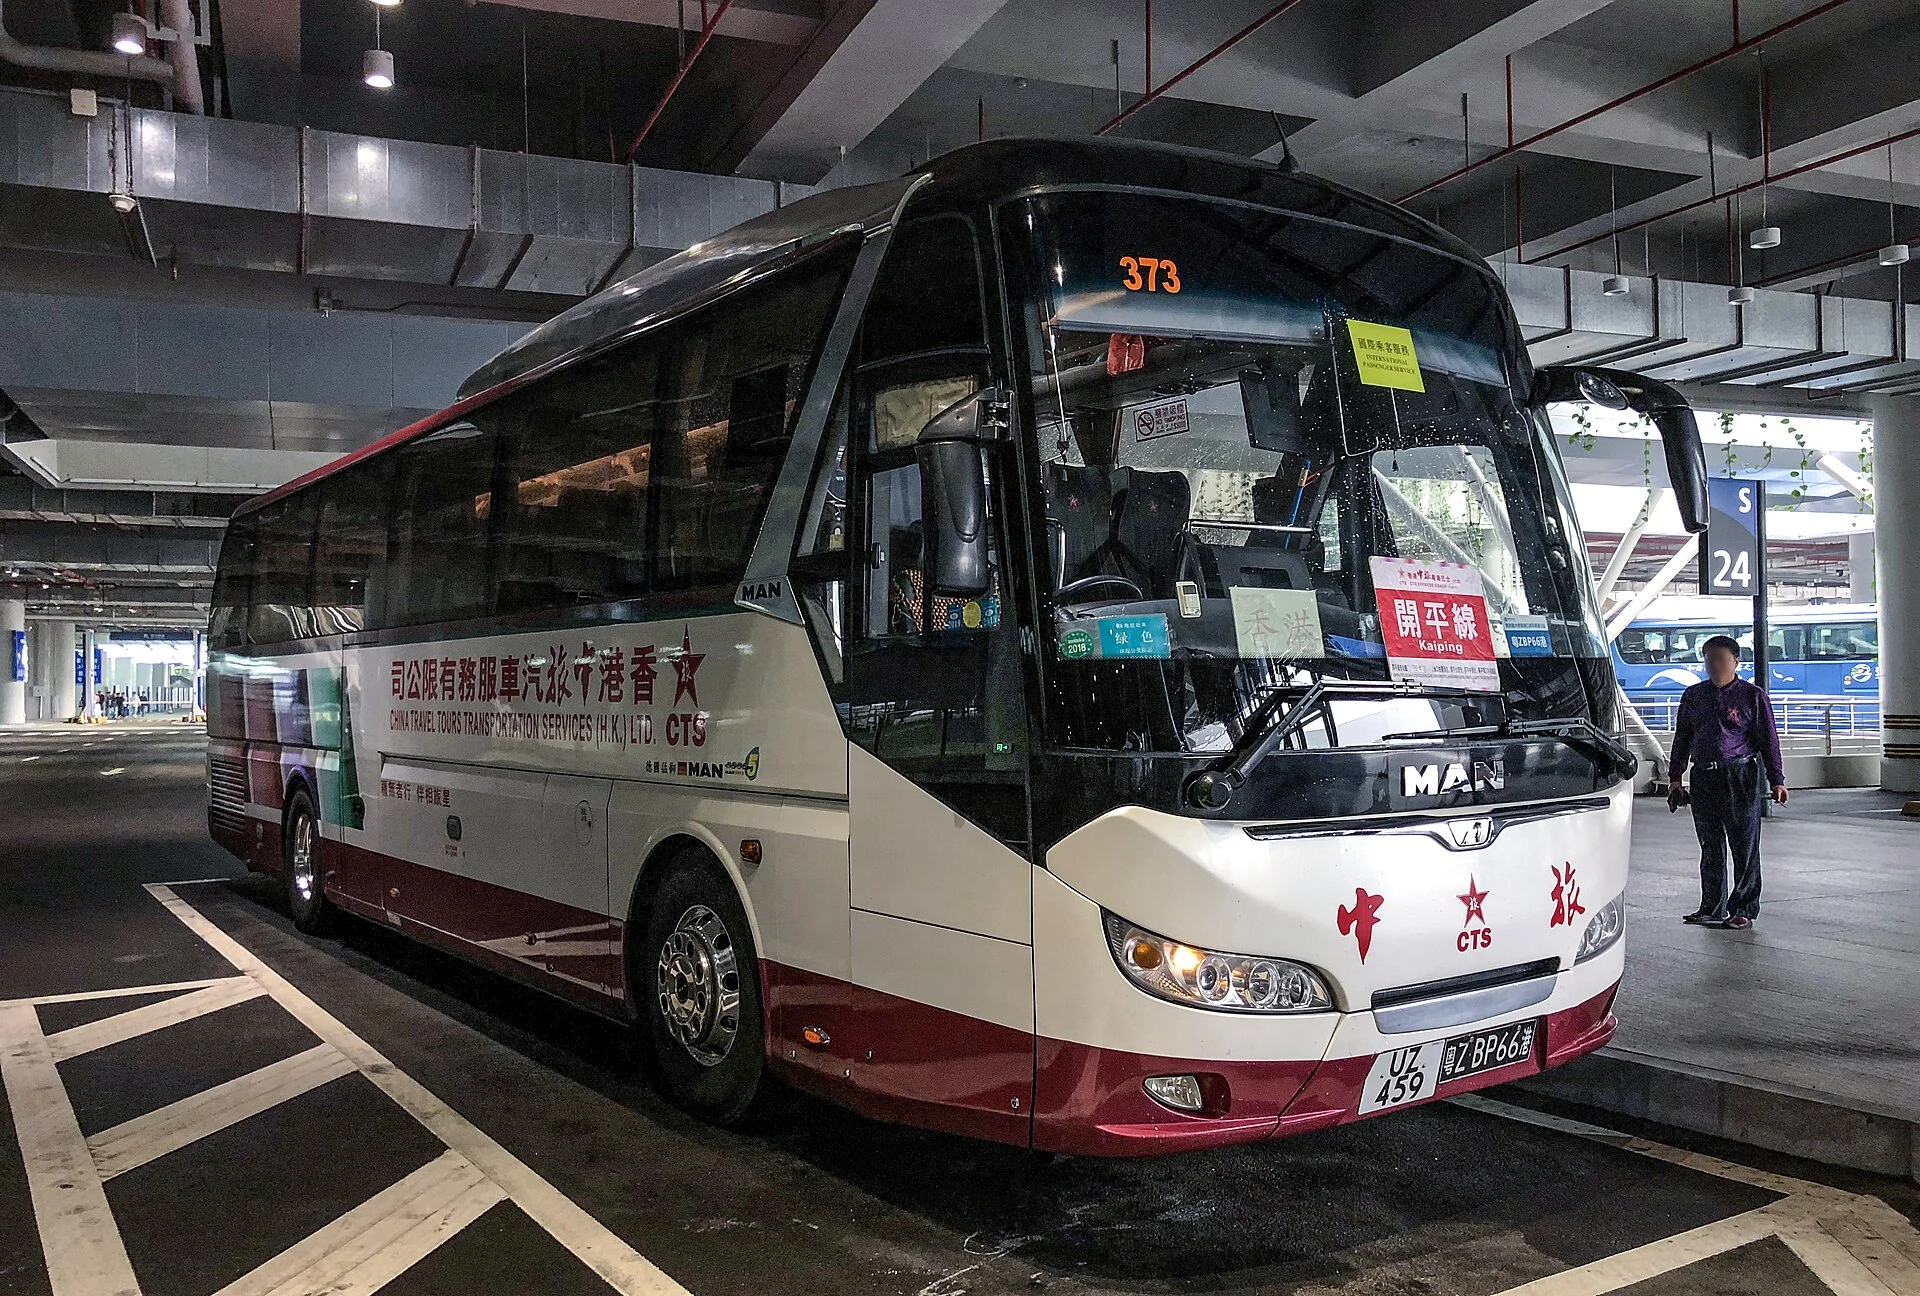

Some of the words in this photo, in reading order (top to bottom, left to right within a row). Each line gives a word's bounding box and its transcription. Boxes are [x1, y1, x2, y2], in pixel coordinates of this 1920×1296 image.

[1119, 256, 1181, 294] 373
[1362, 361, 1393, 371] PASSENGER
[1394, 365, 1415, 375] SERVICE
[1365, 354, 1408, 366] INTERNATIONAL
[1738, 487, 1752, 513] S
[1713, 550, 1751, 588] 24
[742, 582, 781, 600] MAN
[1394, 599, 1478, 640] 開平線
[1068, 643, 1087, 654] 2018
[1115, 630, 1154, 645] 绿色
[1419, 640, 1463, 655] Kaiping
[390, 709, 409, 731] CHINA
[410, 710, 435, 733] TRAVEL
[437, 711, 462, 734] TOURS
[463, 711, 539, 739] TRANSPORTATION
[542, 713, 593, 742] SERVICES
[596, 713, 627, 751] (H.K.)
[630, 714, 656, 745] LTD.
[666, 713, 706, 747] CTS
[688, 761, 723, 779] MAN
[1401, 760, 1504, 797] MAN
[1337, 887, 1384, 966] 中
[1551, 861, 1586, 929] 旅
[1456, 928, 1491, 952] CTS
[1389, 1046, 1423, 1077] UZ
[1374, 1072, 1424, 1106] 459
